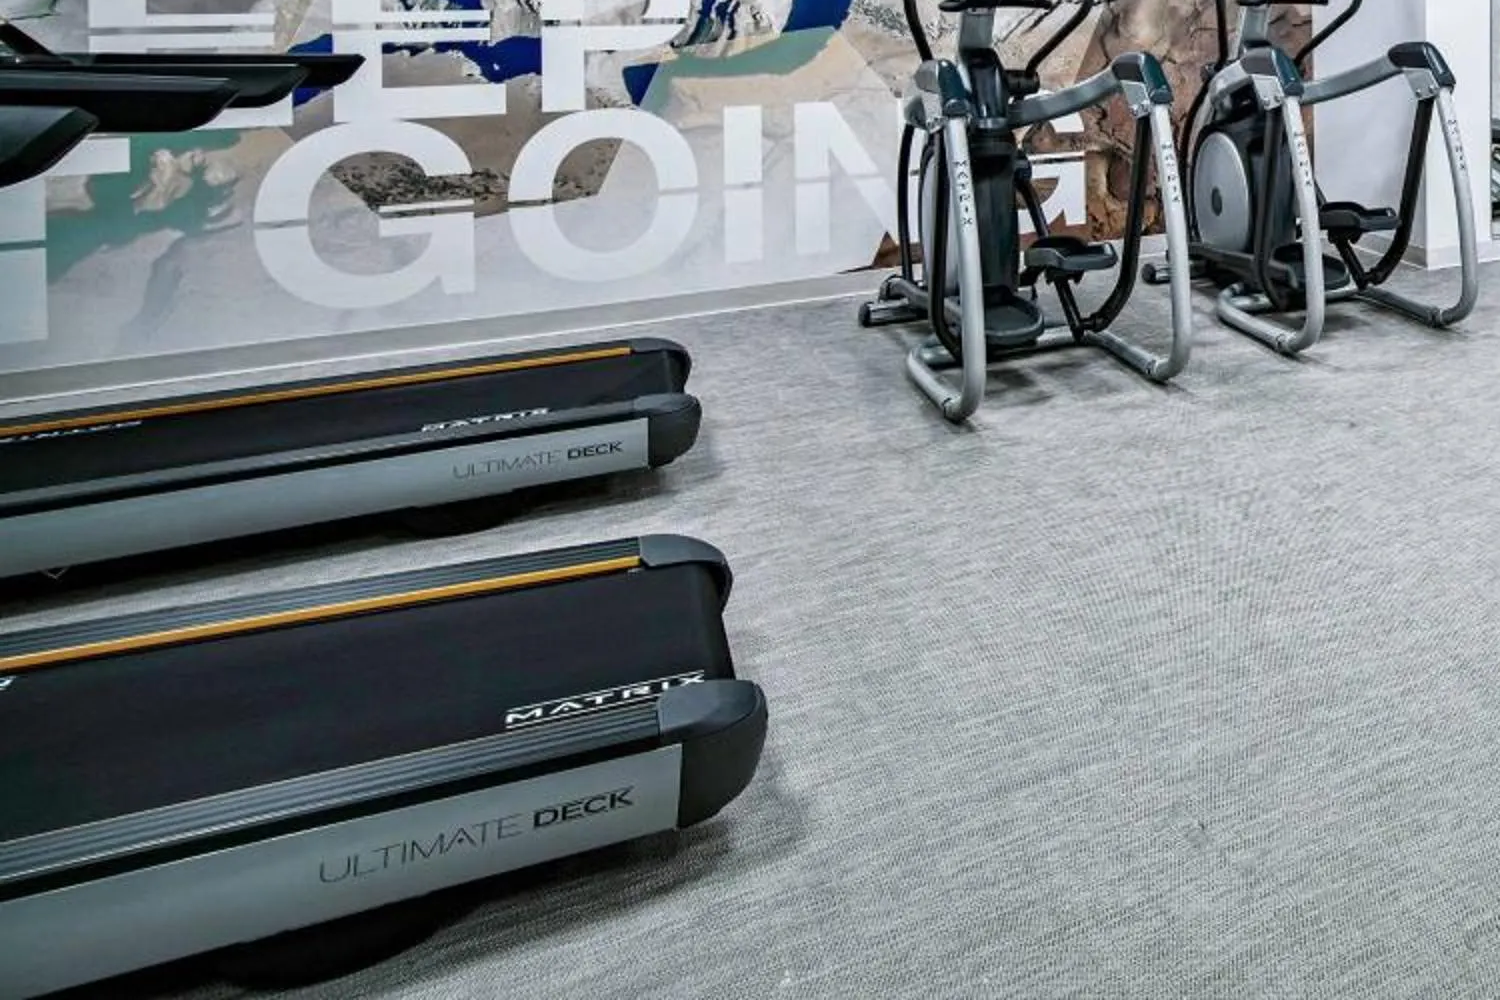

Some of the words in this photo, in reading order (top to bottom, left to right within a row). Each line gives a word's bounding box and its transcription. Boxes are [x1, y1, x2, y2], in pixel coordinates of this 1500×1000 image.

[952, 160, 973, 225] MATRIX
[452, 451, 559, 479] ULTIMATE
[567, 441, 625, 460] DECK
[506, 672, 705, 724] MATRIX
[319, 813, 523, 884] ULTIMATE
[533, 785, 636, 830] DECK
